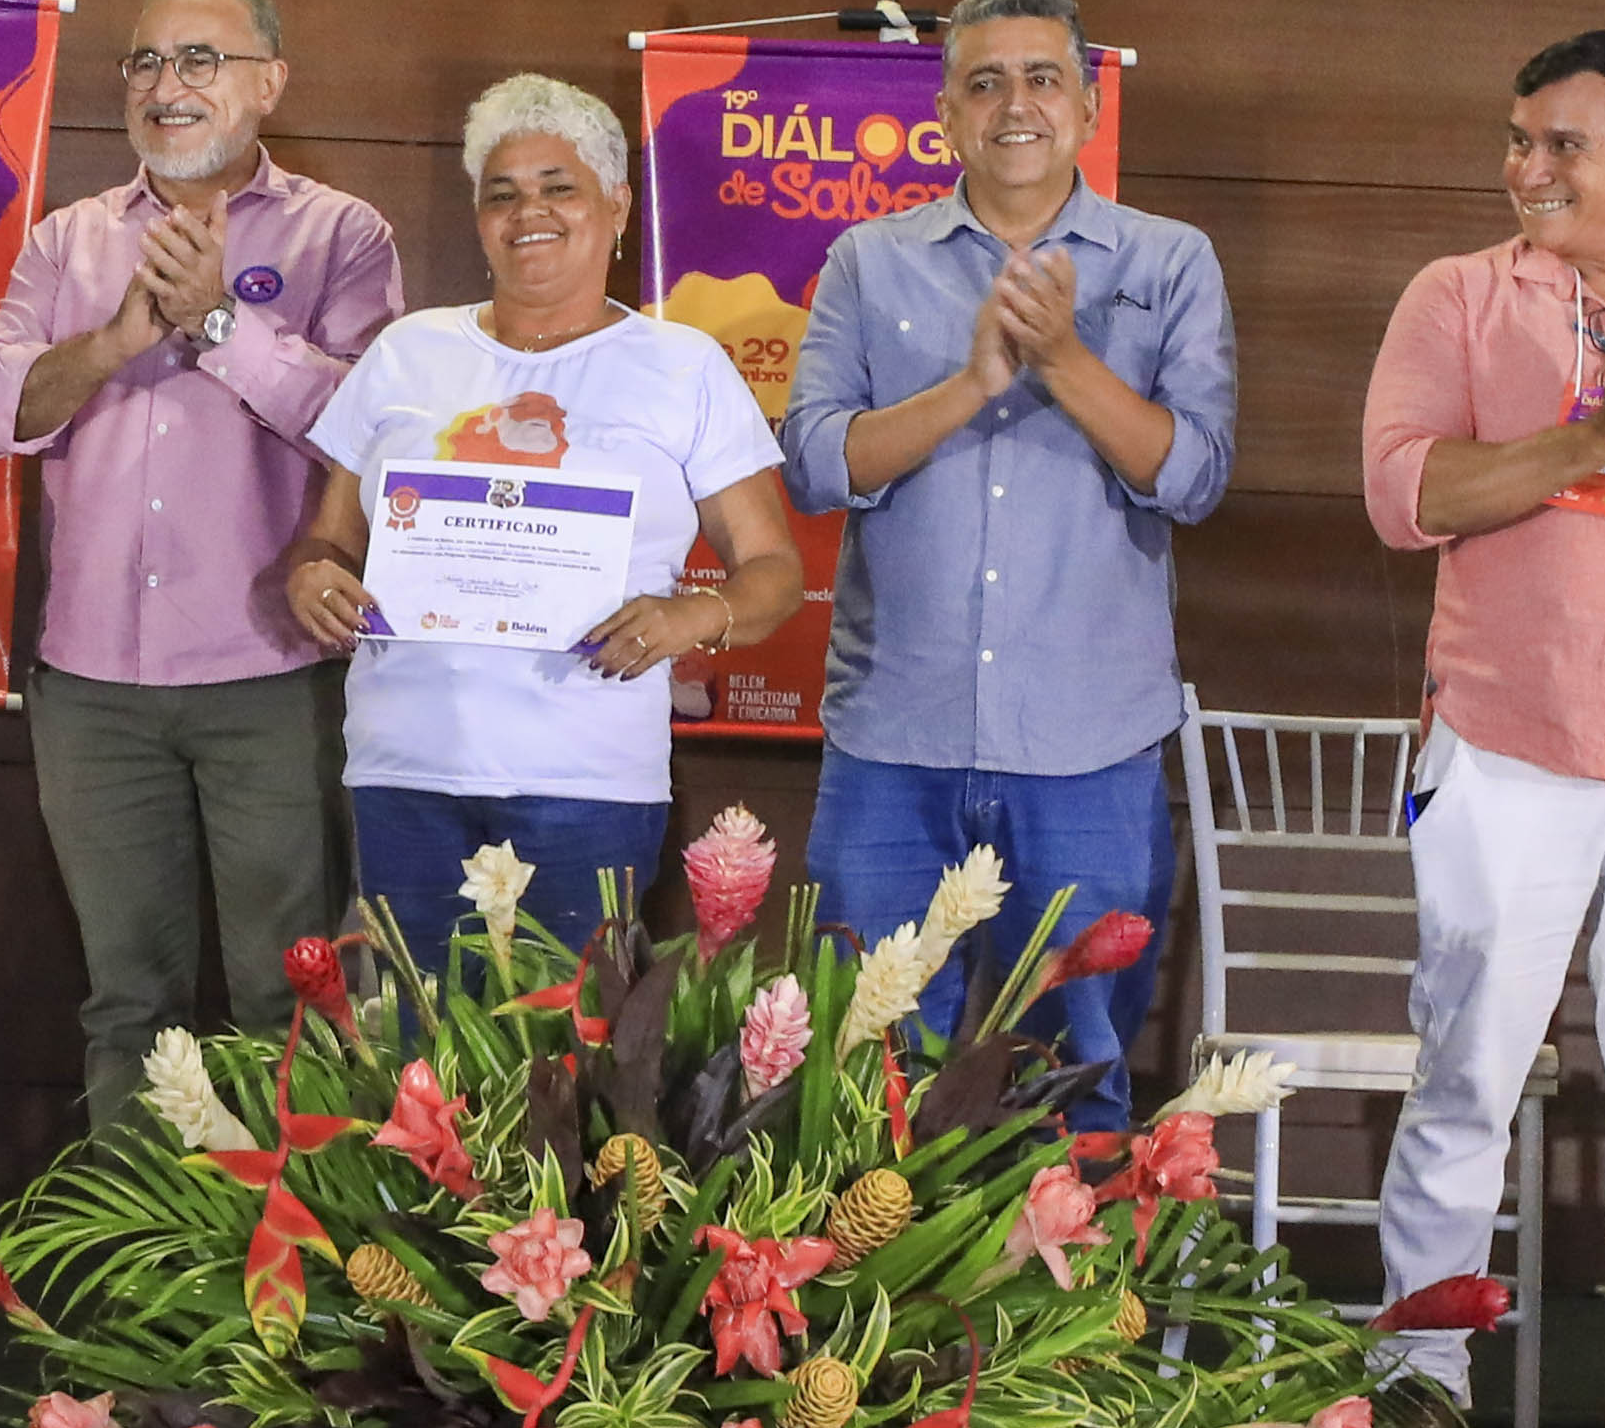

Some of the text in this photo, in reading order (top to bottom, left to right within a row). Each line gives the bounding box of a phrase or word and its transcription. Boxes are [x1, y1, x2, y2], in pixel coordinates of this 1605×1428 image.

[721, 103, 965, 169] DIÁLOG
[719, 161, 955, 221] de Sabe
[741, 337, 789, 365] 29
[443, 516, 558, 536] CERTIFICADO
[510, 620, 548, 633] Belém
